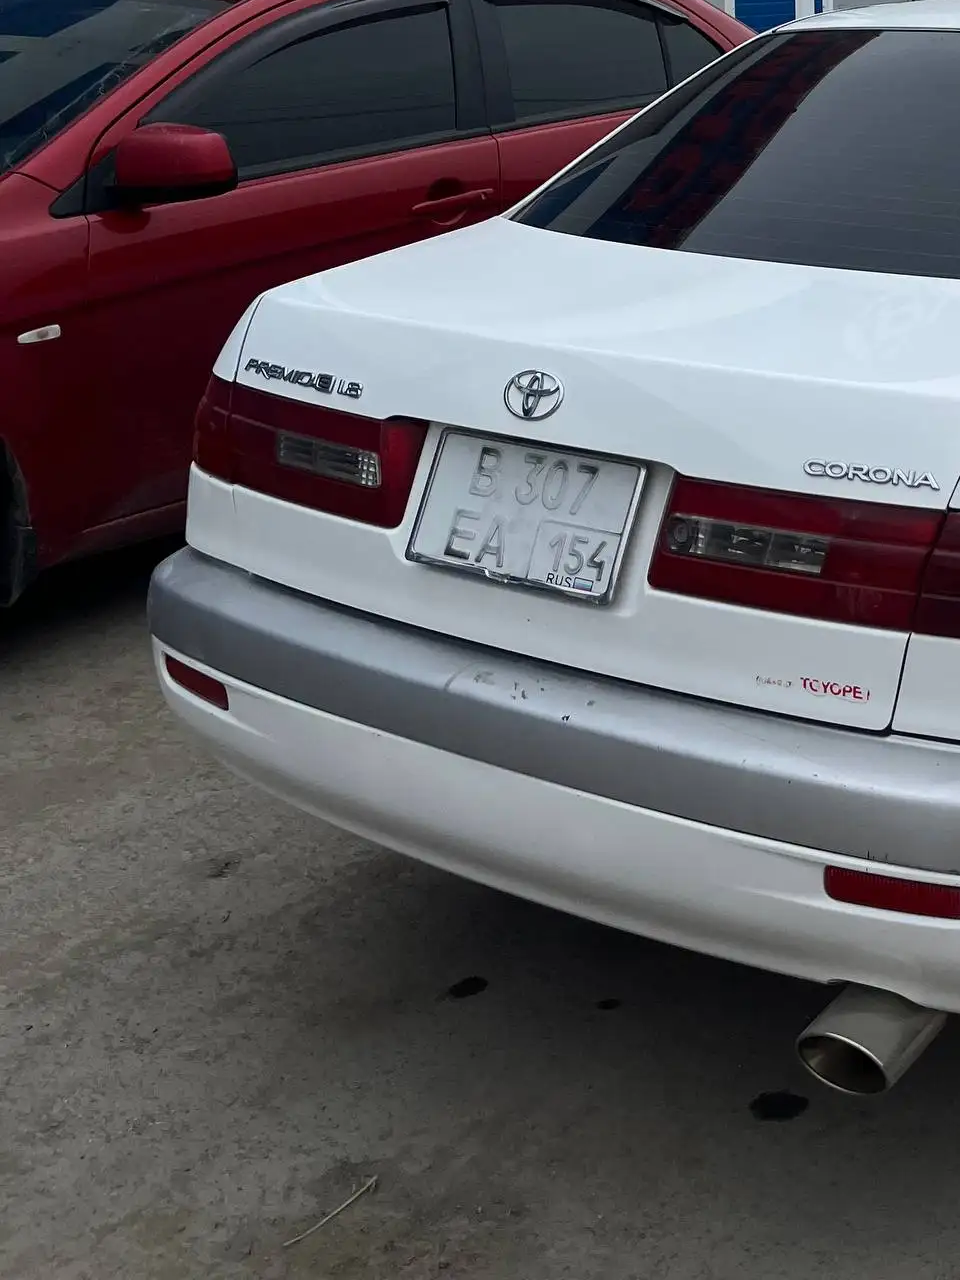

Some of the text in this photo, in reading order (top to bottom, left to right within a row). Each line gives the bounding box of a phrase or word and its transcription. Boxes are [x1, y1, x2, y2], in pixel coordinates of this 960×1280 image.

[515, 452, 599, 515] 307
[803, 456, 940, 491] CORONA
[549, 531, 608, 582] 154
[546, 572, 573, 588] RUS
